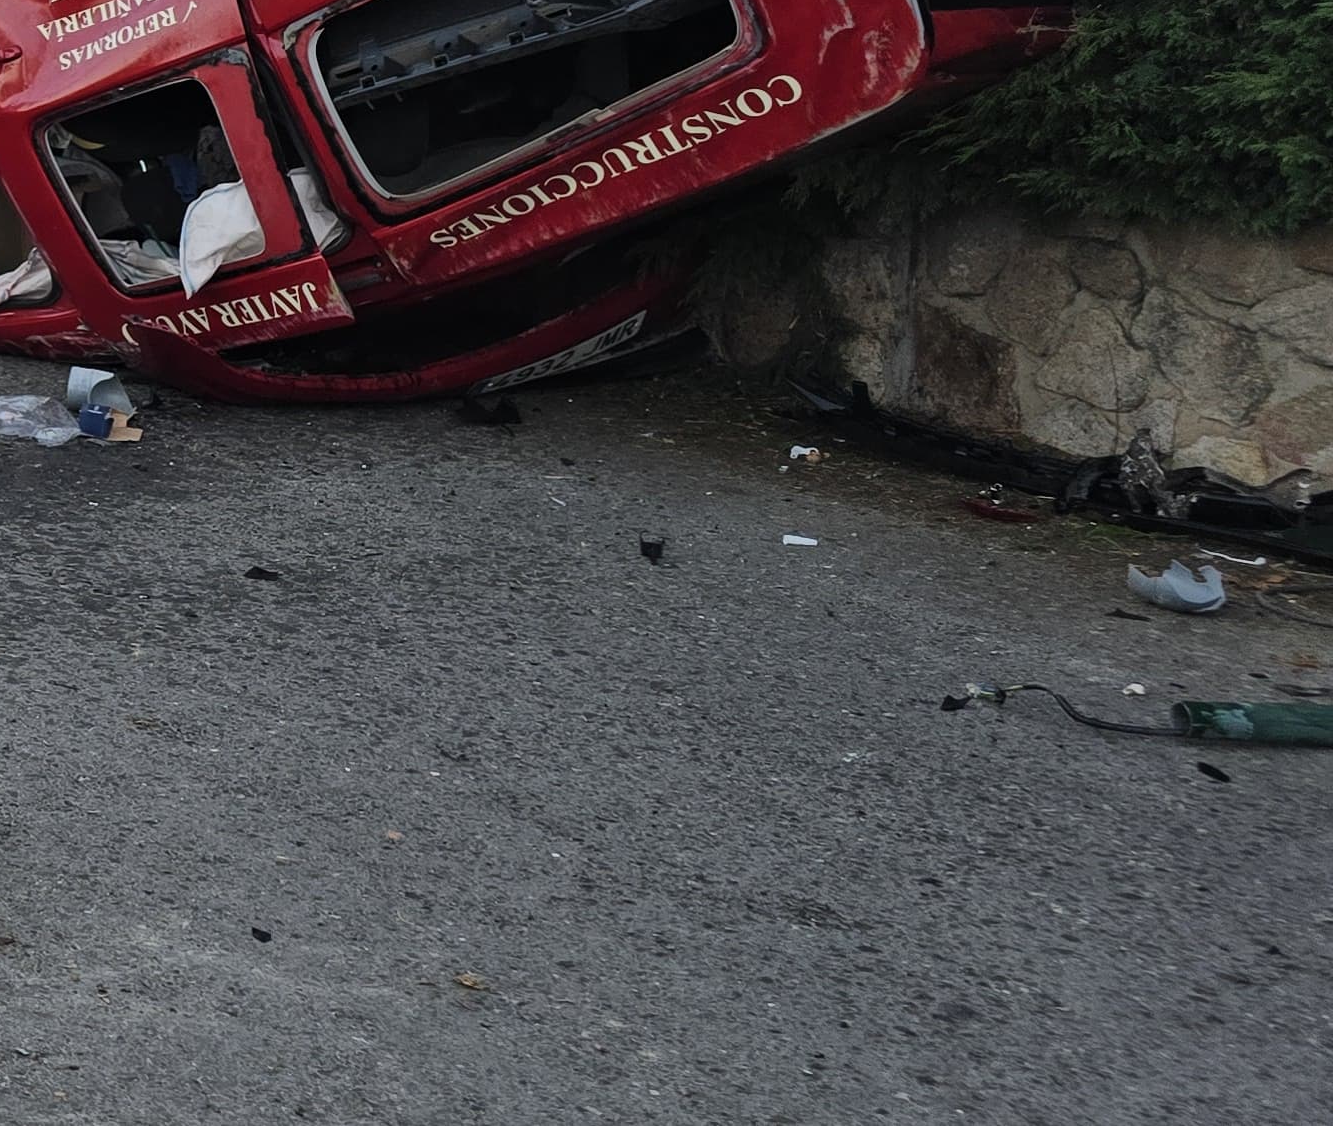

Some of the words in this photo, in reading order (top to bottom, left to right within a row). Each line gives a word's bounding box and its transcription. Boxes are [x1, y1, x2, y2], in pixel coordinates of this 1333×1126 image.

[59, 6, 178, 71] REFORMAS
[429, 75, 803, 249] CONSTRUCCIONES
[121, 305, 211, 346] AYU
[210, 281, 324, 329] JAVIER
[584, 318, 639, 358] JMR
